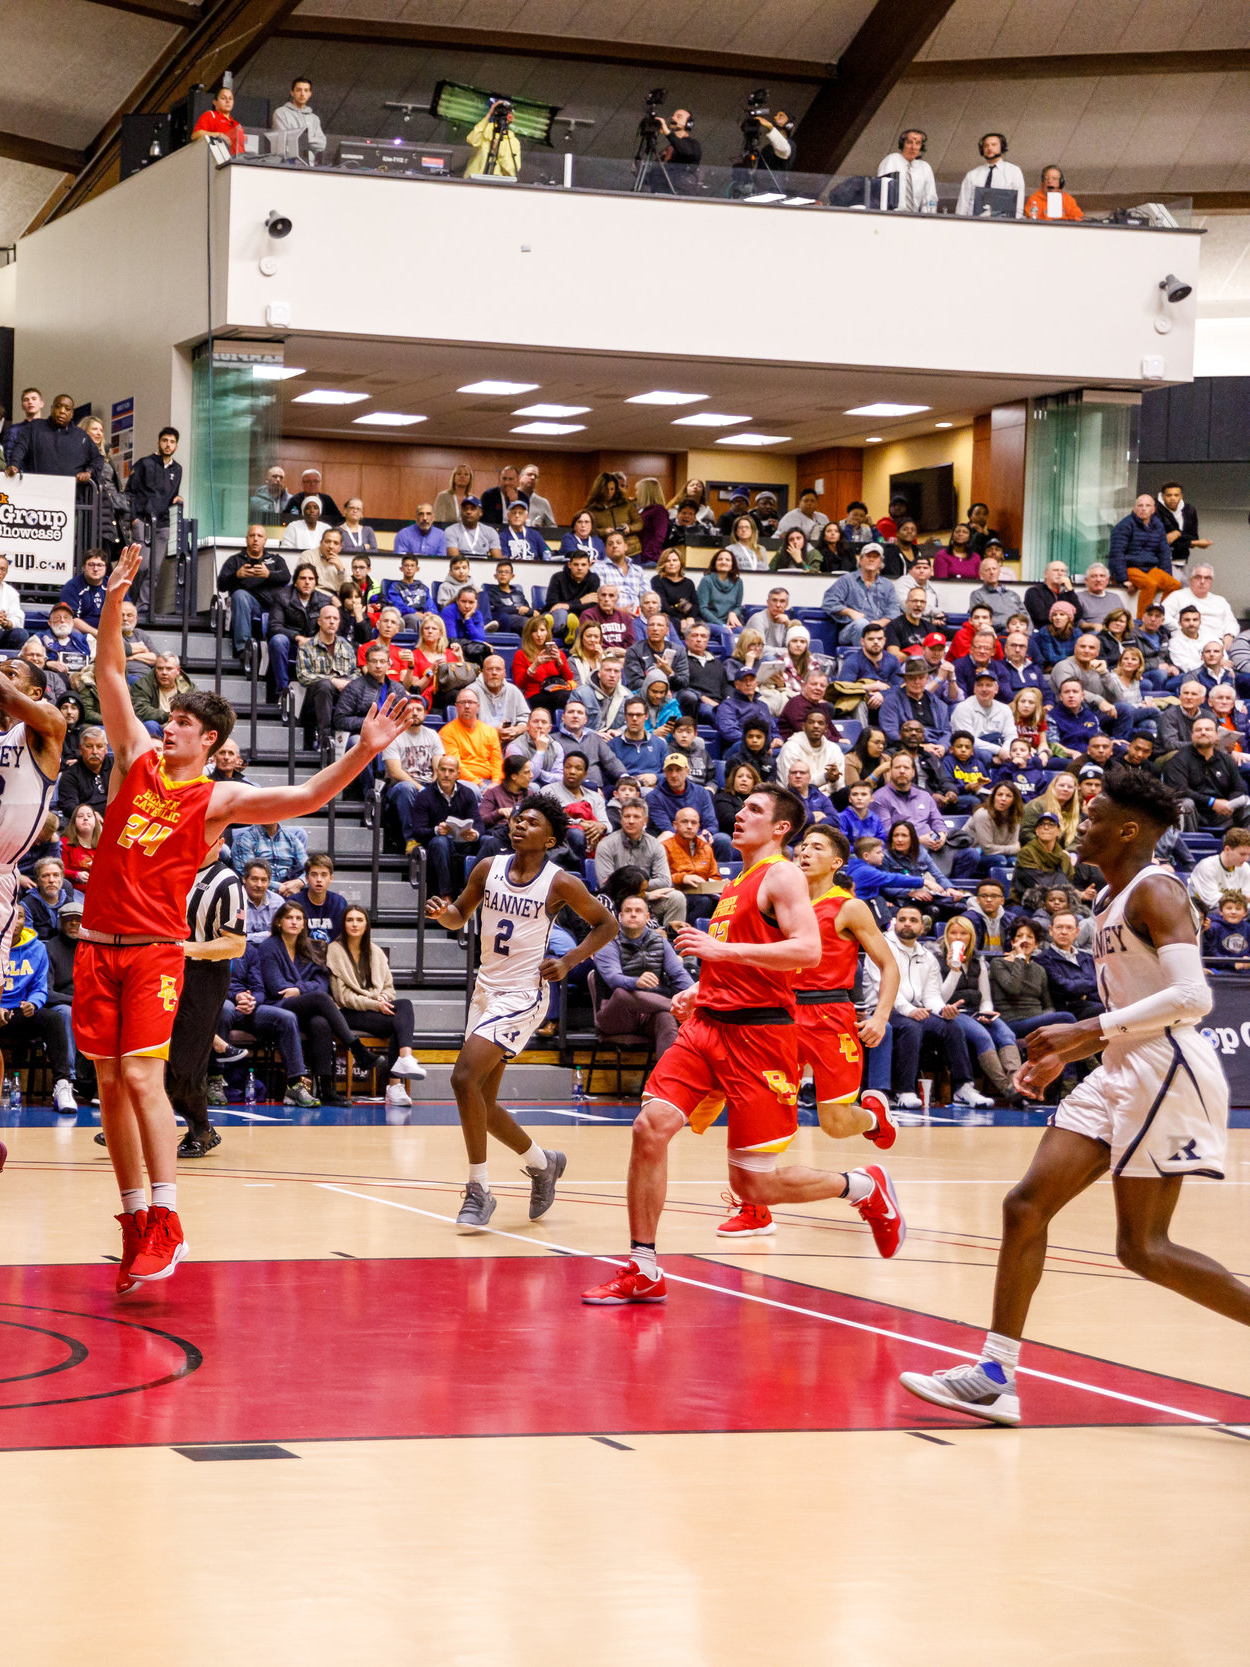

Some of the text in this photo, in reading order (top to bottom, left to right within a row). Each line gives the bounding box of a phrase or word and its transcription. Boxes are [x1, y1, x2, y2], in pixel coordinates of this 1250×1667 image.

[117, 814, 173, 857] 24
[484, 889, 544, 919] RANNEY
[494, 918, 514, 956] 2
